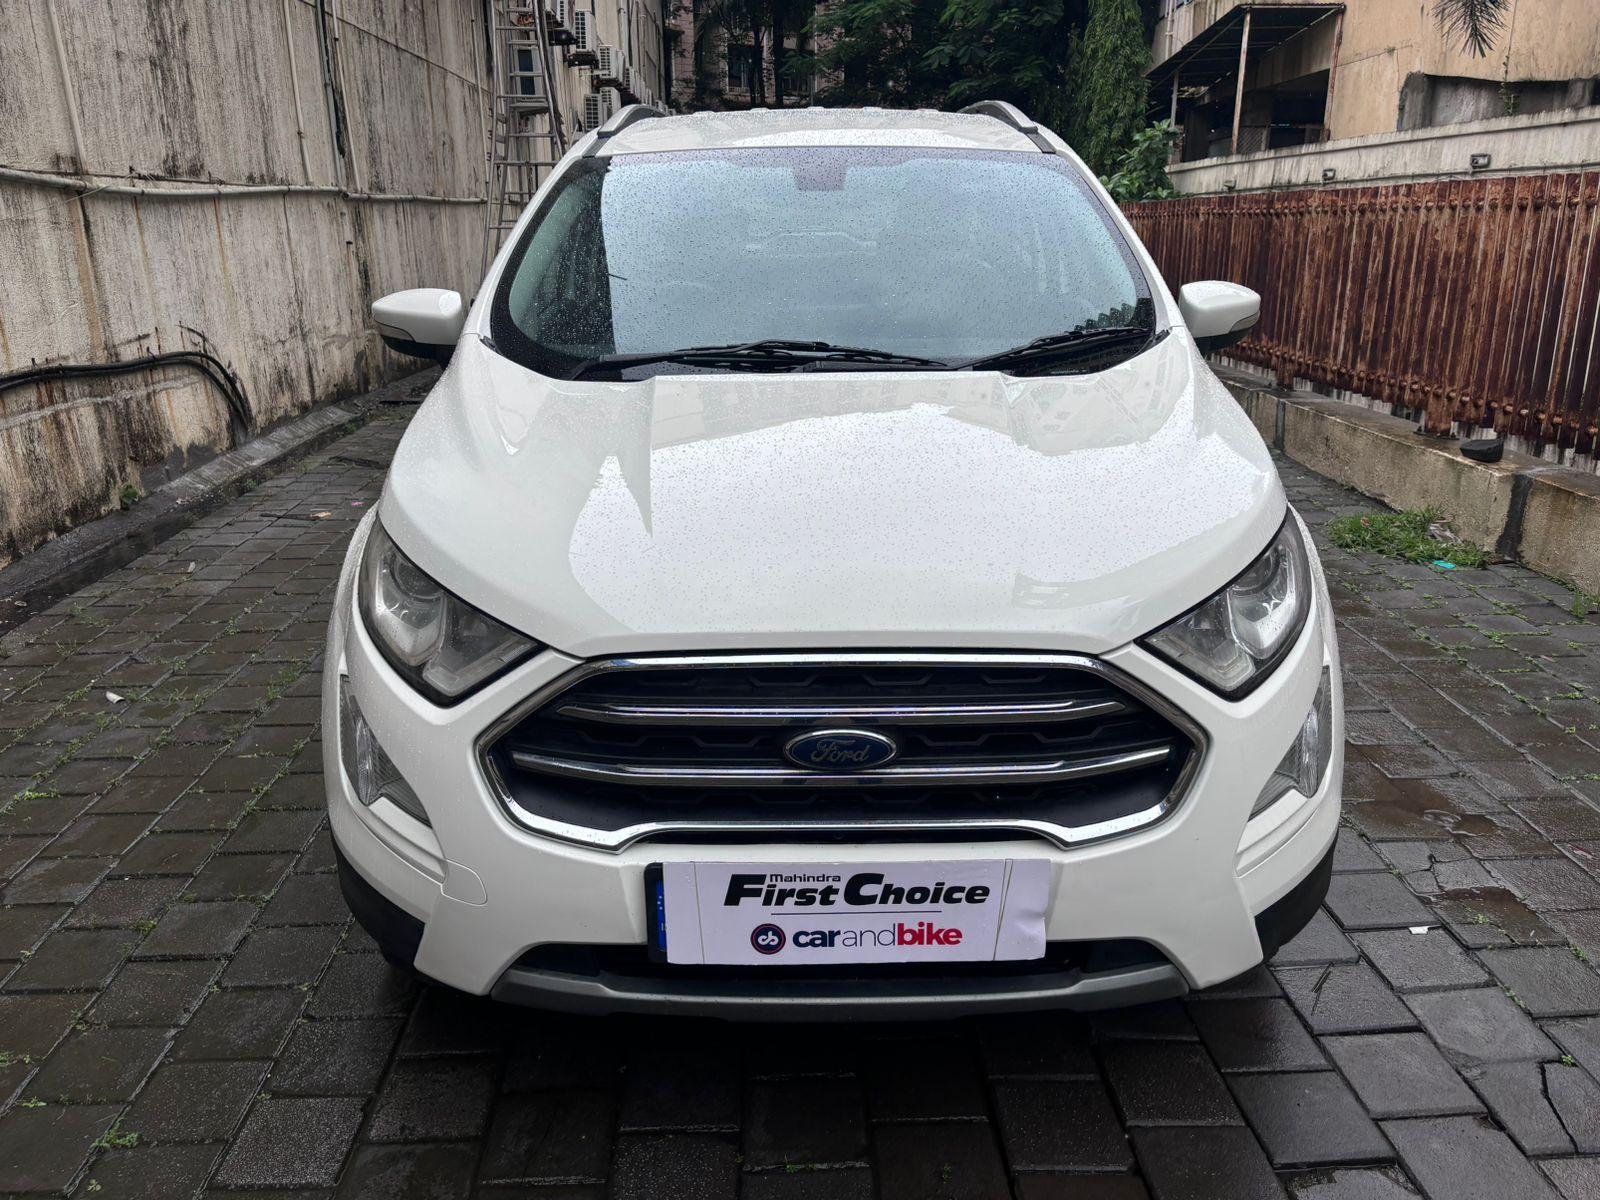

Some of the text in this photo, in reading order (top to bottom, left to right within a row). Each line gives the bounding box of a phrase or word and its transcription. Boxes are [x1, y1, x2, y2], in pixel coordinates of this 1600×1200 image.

[811, 740, 871, 762] Ford
[723, 873, 990, 906] First Choice
[769, 873, 841, 883] Mahindra
[792, 921, 963, 948] carandbike
